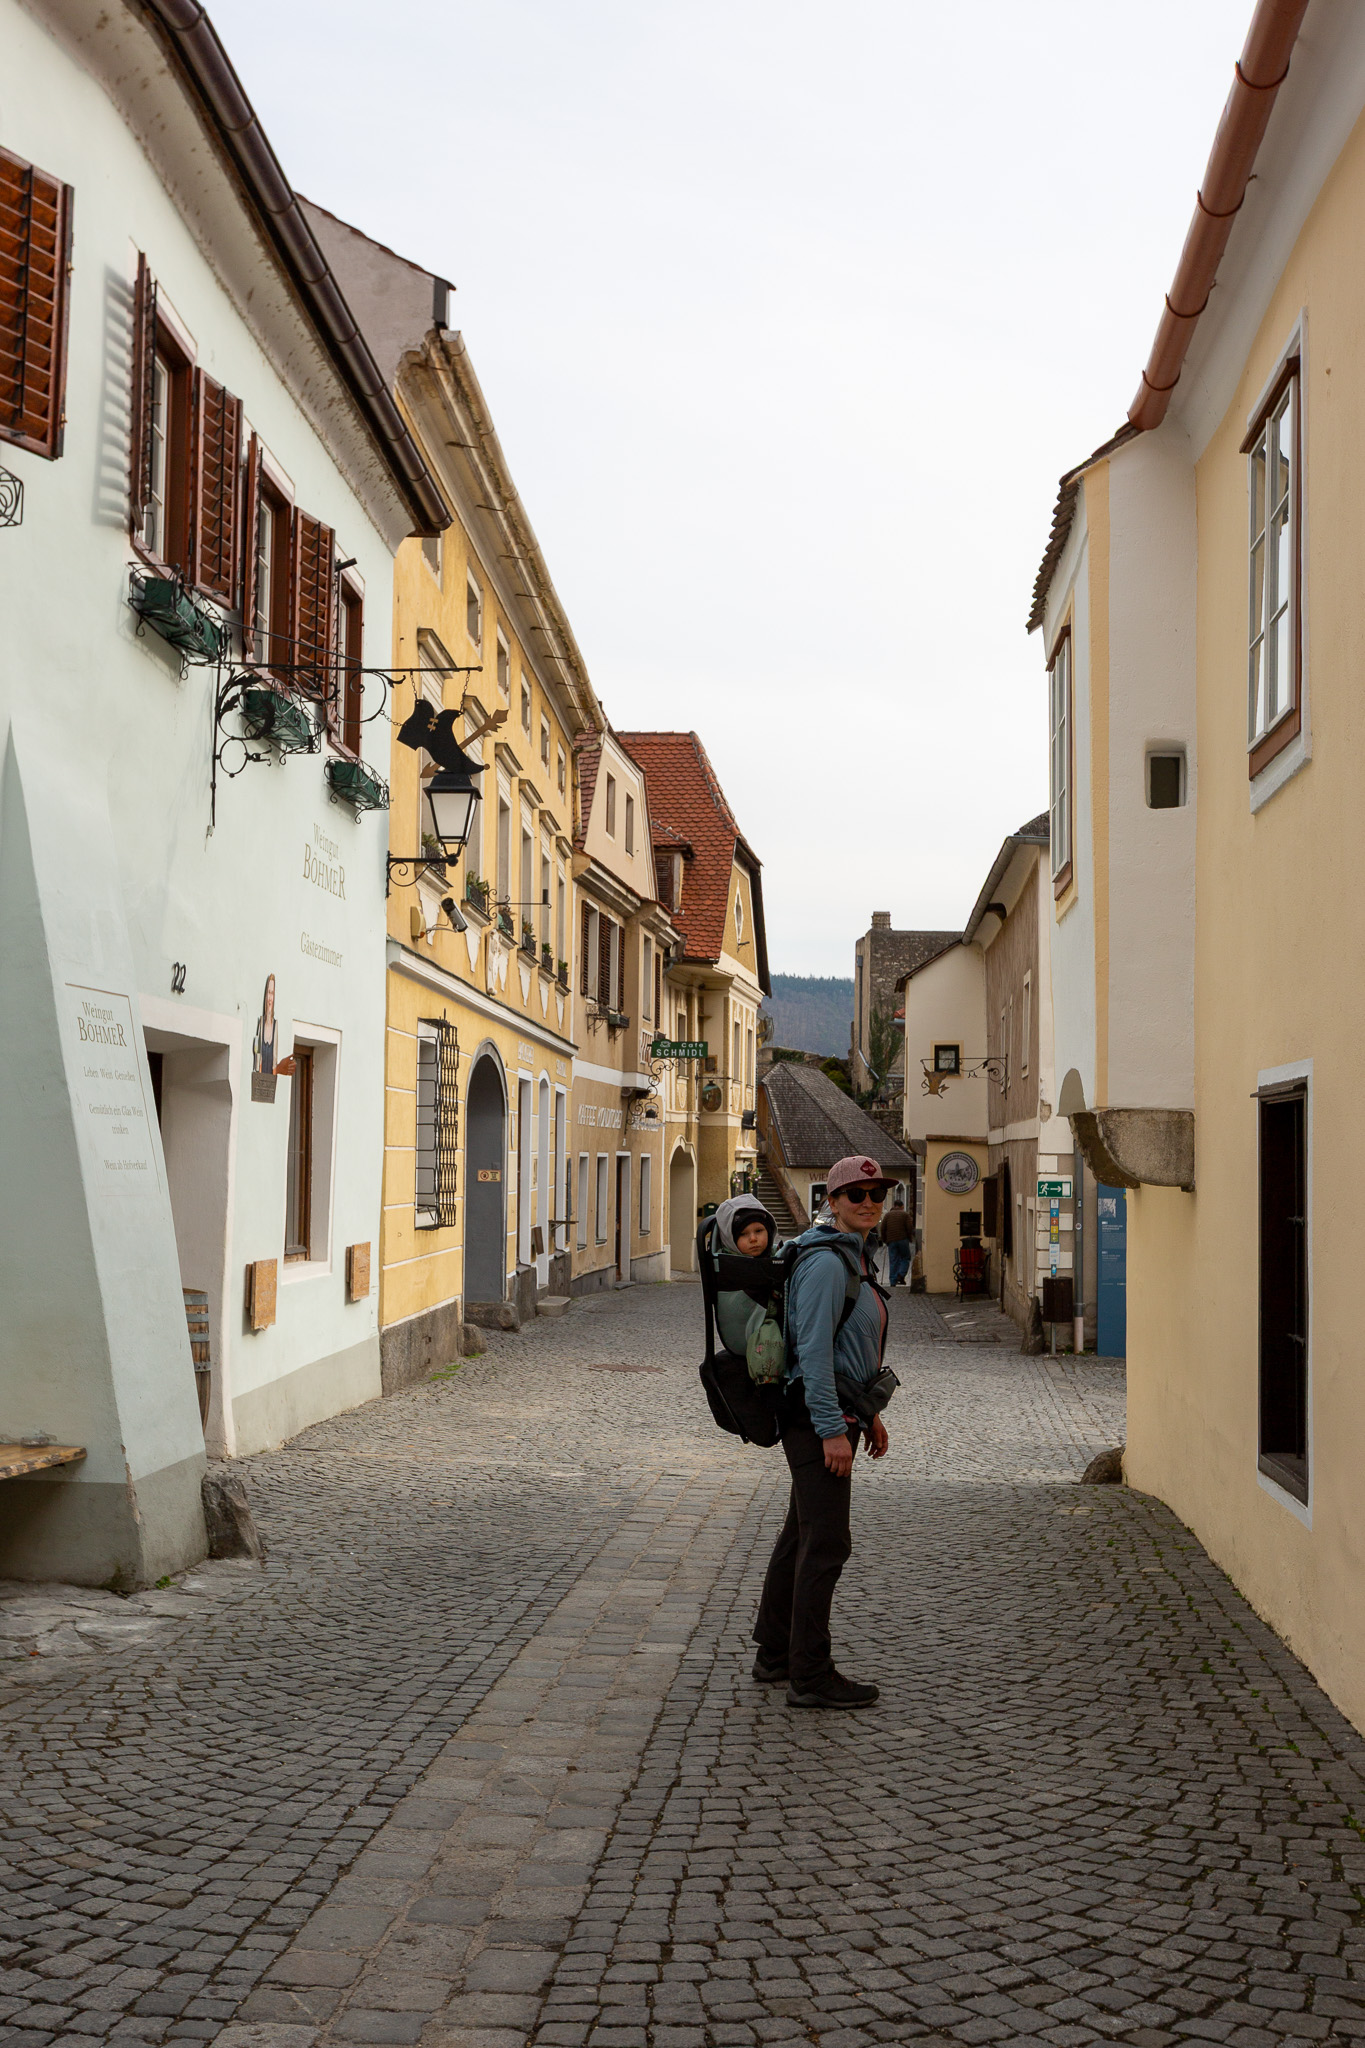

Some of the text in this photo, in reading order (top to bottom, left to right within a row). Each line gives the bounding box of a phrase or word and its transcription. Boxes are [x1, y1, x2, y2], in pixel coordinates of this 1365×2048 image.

[313, 823, 339, 861] Weingut
[303, 843, 346, 900] BÖHMER
[300, 931, 343, 968] Gästezimmer
[171, 961, 186, 994] 22
[82, 1001, 114, 1024] Weingut
[77, 1016, 127, 1047] BÖHMER
[656, 1049, 704, 1057] SCHMIDL
